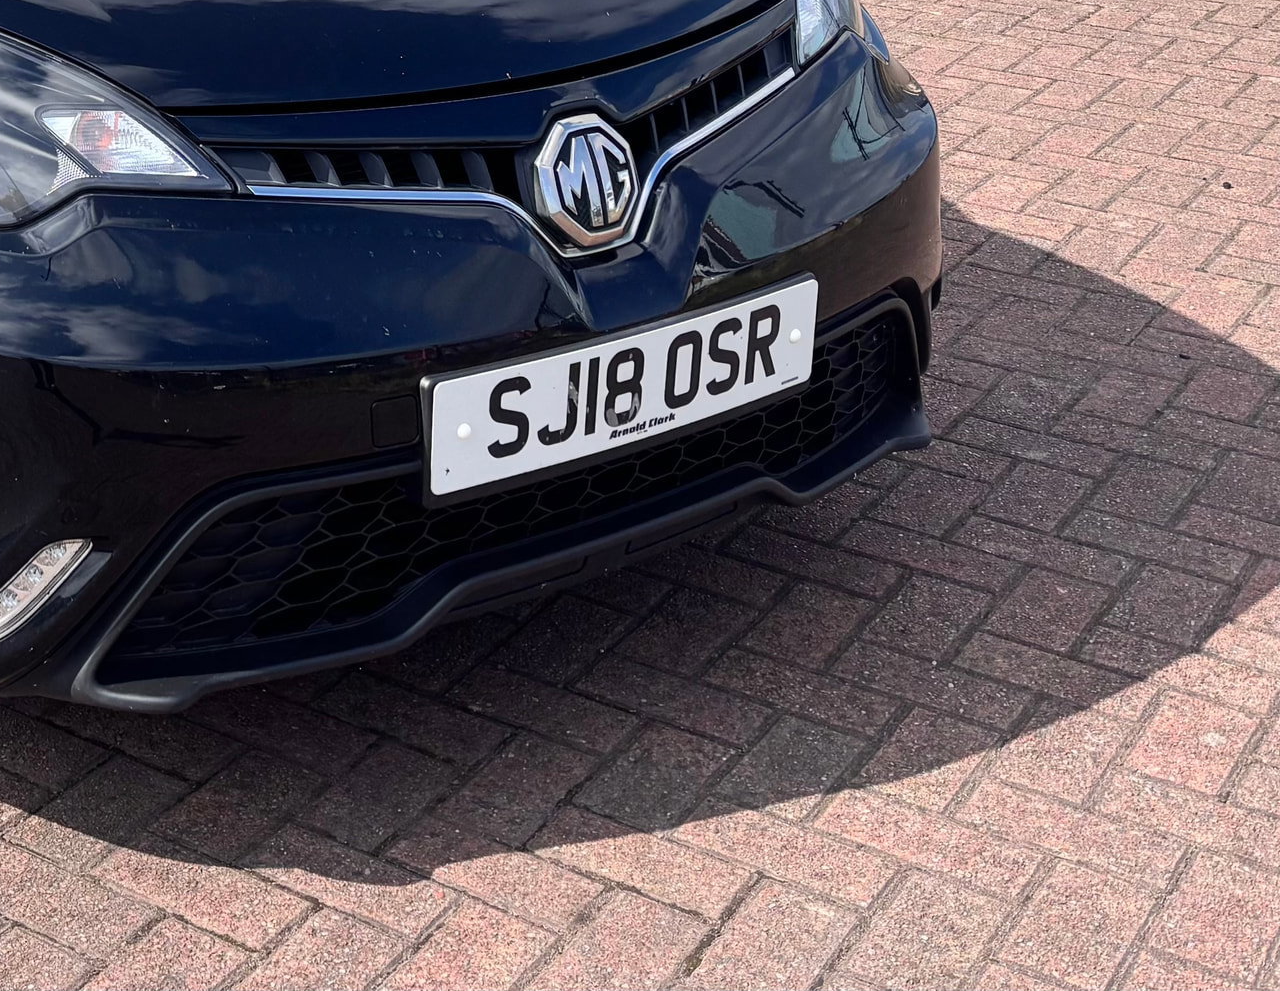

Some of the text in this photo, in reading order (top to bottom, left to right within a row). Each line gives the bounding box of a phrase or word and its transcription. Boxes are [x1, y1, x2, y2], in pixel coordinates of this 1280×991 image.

[557, 132, 632, 228] MG
[487, 346, 646, 459] SJ18
[609, 412, 676, 440] Arnold Clark
